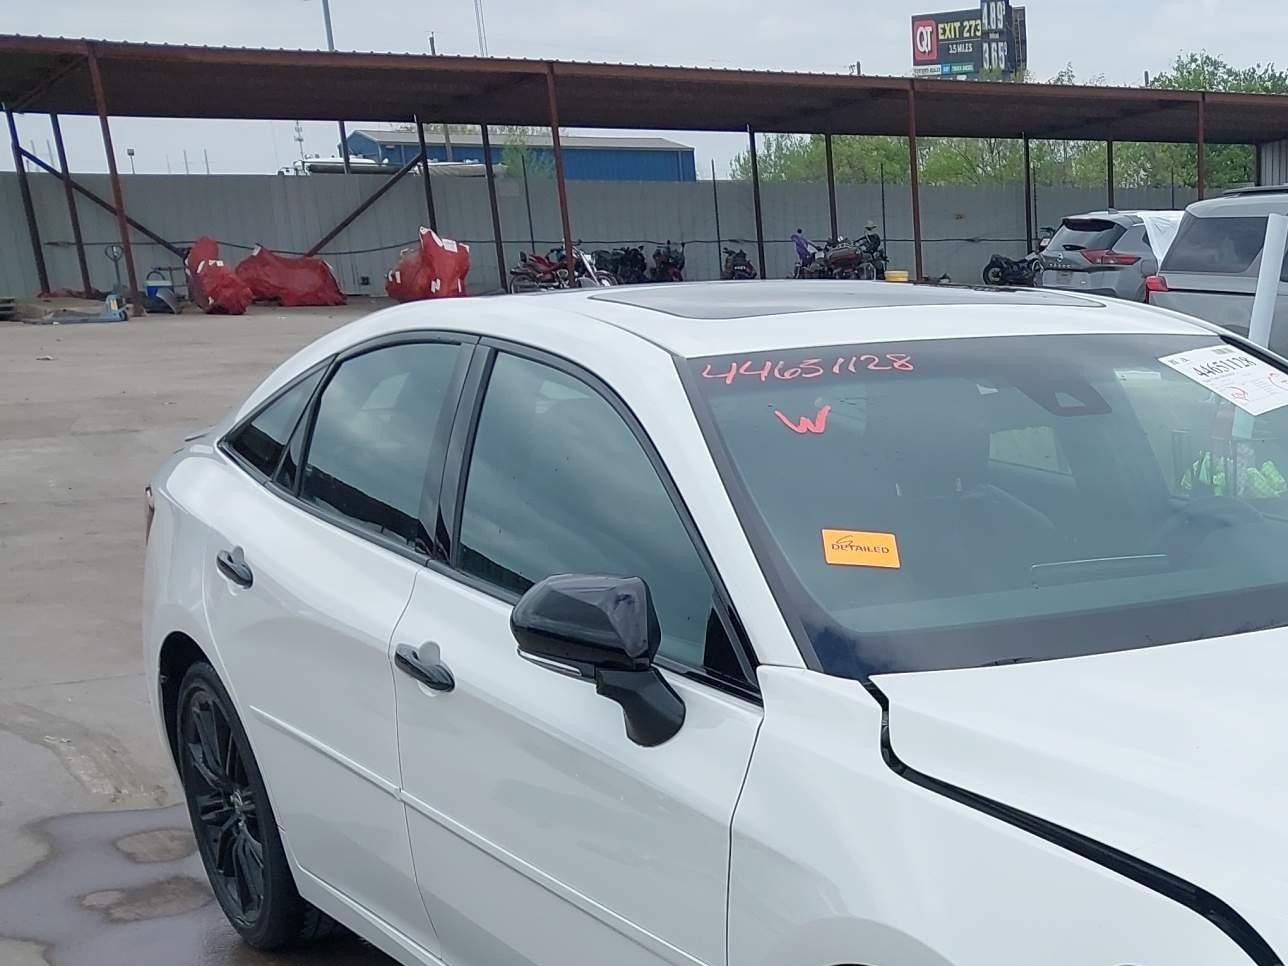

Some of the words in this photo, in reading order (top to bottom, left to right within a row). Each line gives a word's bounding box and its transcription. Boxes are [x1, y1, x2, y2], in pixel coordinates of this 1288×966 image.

[916, 26, 932, 54] QT
[938, 22, 960, 40] EXIT
[962, 19, 982, 38] 273
[702, 353, 914, 385] 44651128
[1192, 356, 1257, 378] 44651128
[774, 404, 832, 434] W
[831, 543, 890, 553] DETAILED
